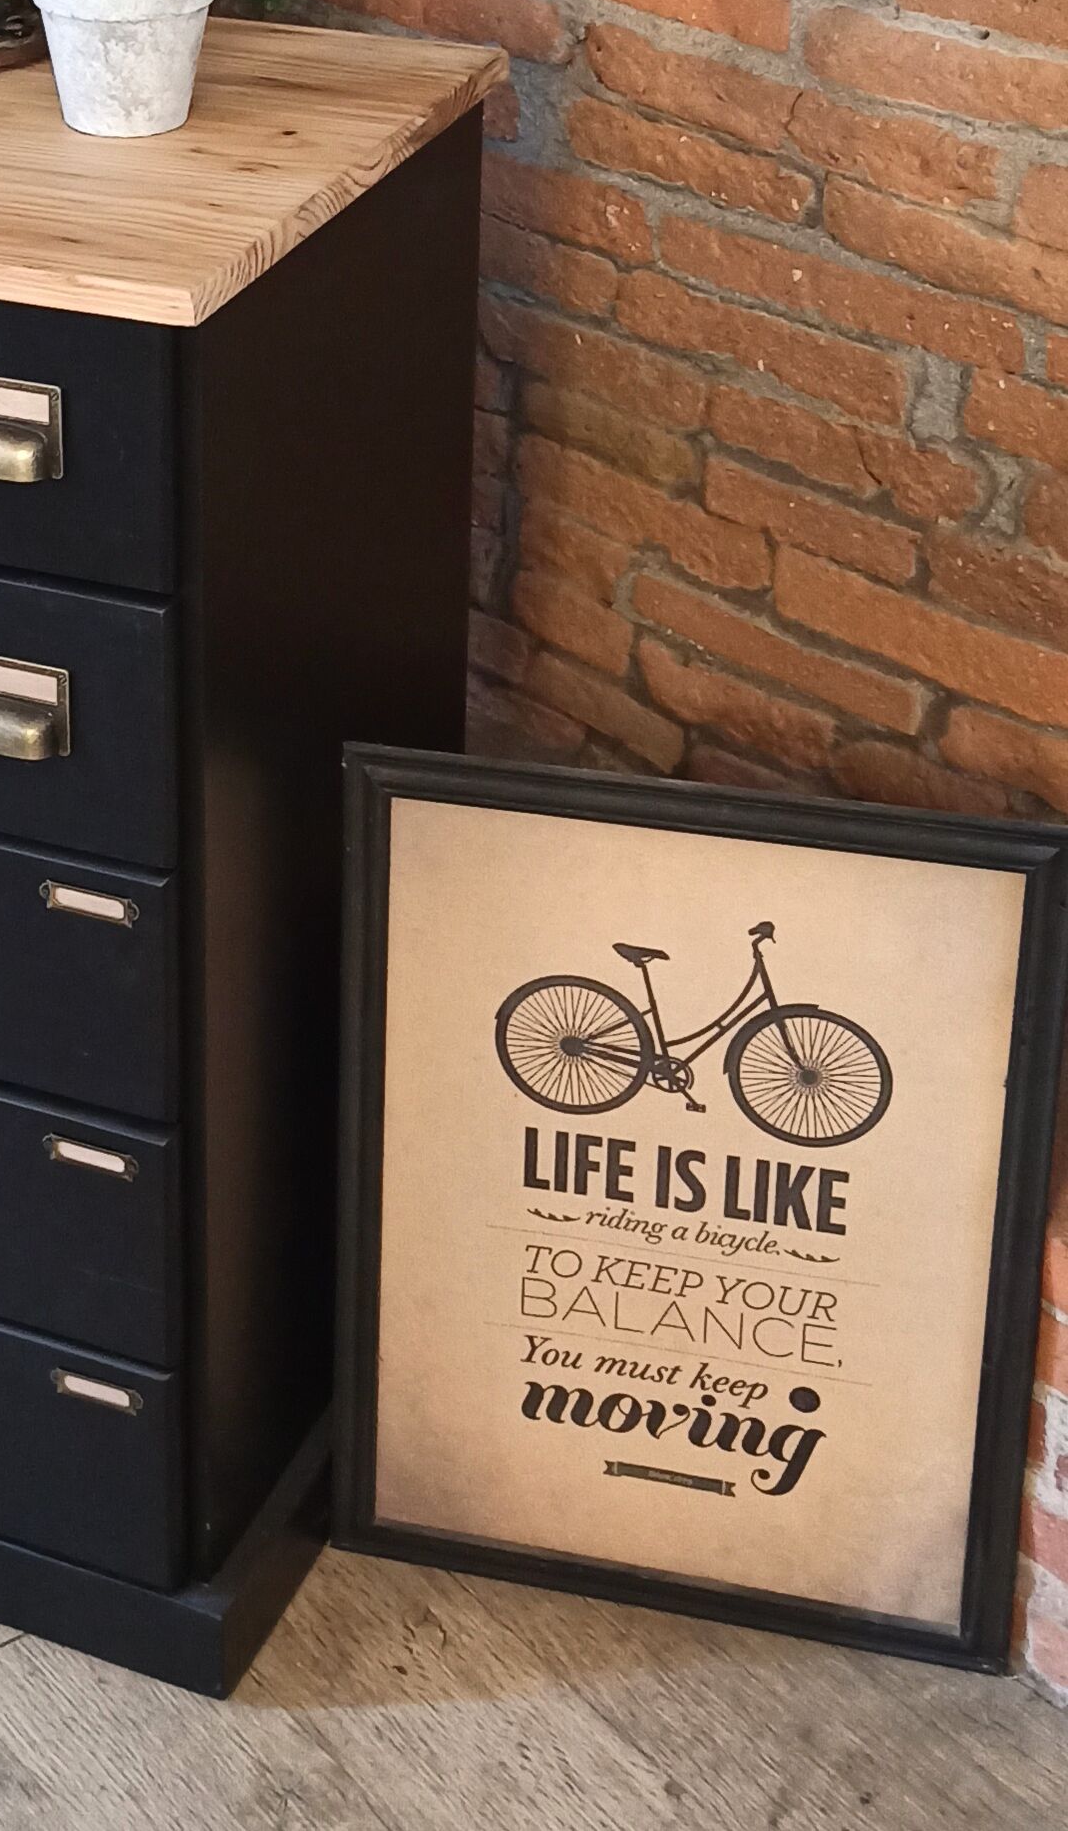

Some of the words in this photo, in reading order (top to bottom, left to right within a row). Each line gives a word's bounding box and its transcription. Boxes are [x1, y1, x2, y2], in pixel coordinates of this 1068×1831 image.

[523, 1126, 635, 1203] LIFE
[656, 1145, 706, 1212] IS
[724, 1155, 849, 1235] LIKE
[586, 1206, 667, 1244] riding
[671, 1224, 688, 1241] a
[521, 1277, 842, 1367] BALANCE,
[525, 1244, 582, 1278] TO
[592, 1255, 702, 1297] KEEP
[716, 1275, 837, 1322] YOUR
[521, 1335, 582, 1369] You
[594, 1353, 681, 1385] must
[689, 1362, 768, 1409] keep
[521, 1381, 826, 1496] moving
